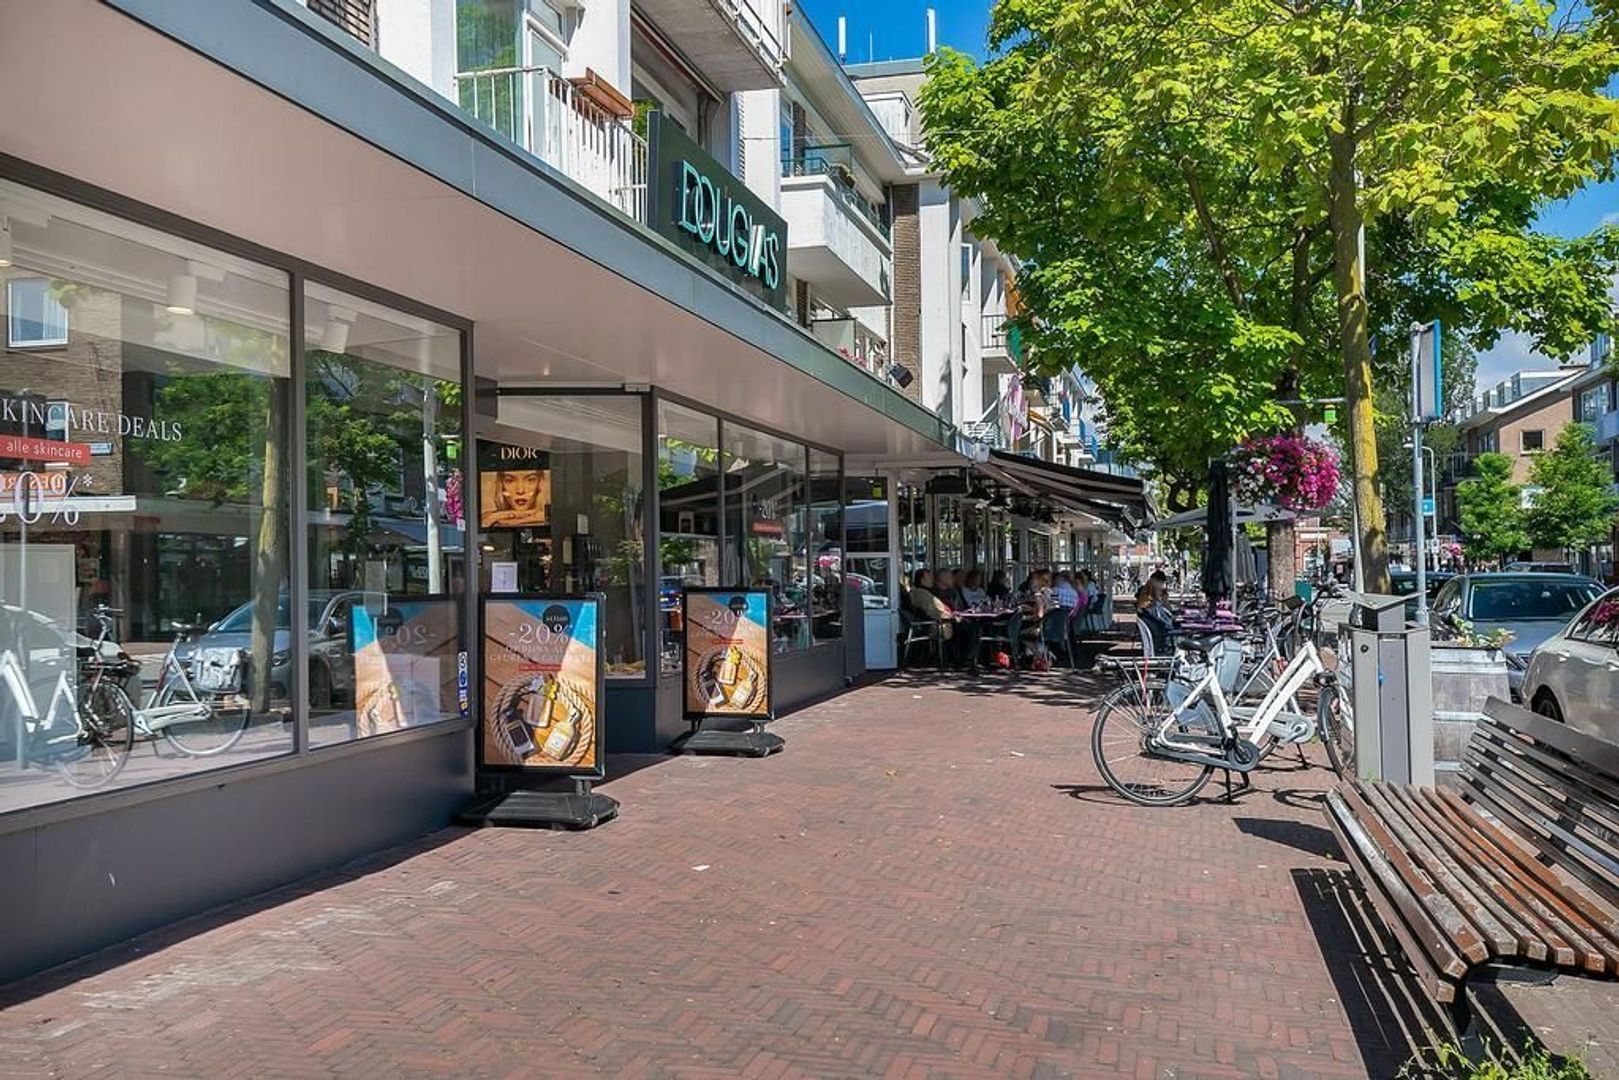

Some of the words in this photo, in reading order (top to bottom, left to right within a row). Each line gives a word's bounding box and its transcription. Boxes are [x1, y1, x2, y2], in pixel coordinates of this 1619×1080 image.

[678, 160, 779, 289] DOUGLAS
[2, 398, 110, 434] KINCARE
[117, 414, 182, 442] DEALS
[6, 441, 29, 453] alle
[33, 444, 82, 458] skincare
[500, 446, 538, 460] DIOR
